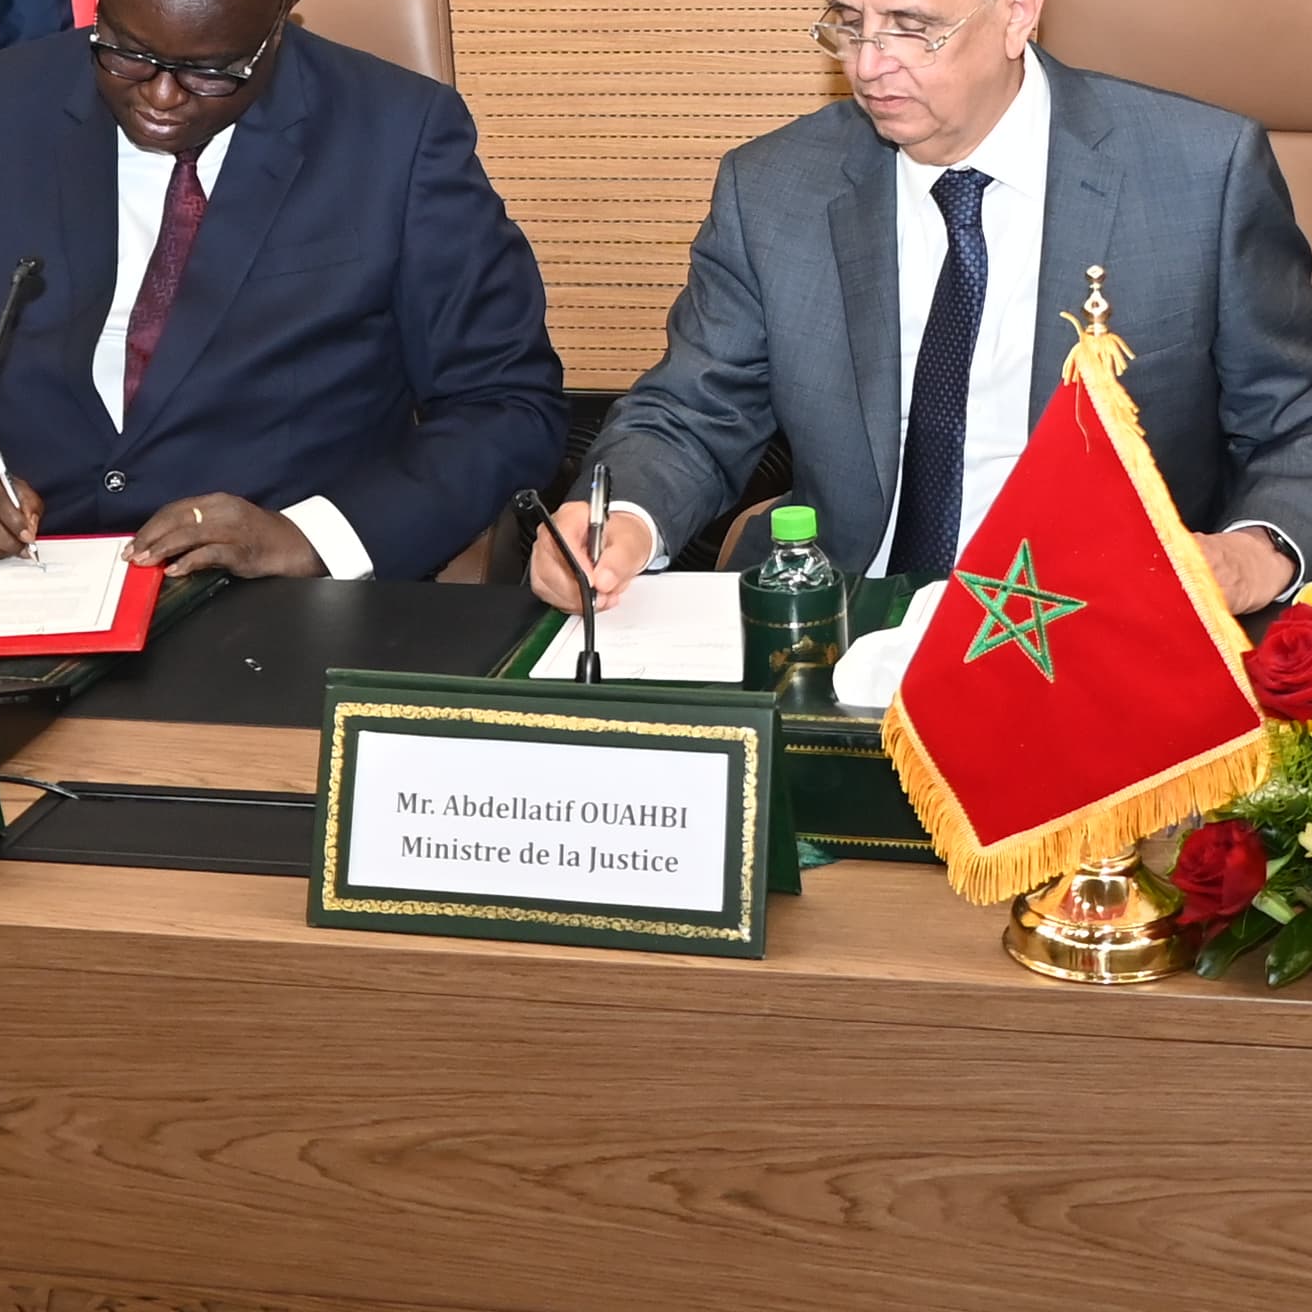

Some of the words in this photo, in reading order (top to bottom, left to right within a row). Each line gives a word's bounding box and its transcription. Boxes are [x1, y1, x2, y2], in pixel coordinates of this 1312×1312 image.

[396, 791, 436, 815] Mr.
[442, 794, 577, 823] Abdellatif
[580, 801, 688, 829] OUAHBI
[401, 835, 512, 864] Ministre
[518, 841, 551, 866] de
[557, 843, 581, 868] la
[588, 845, 679, 874] Justice
